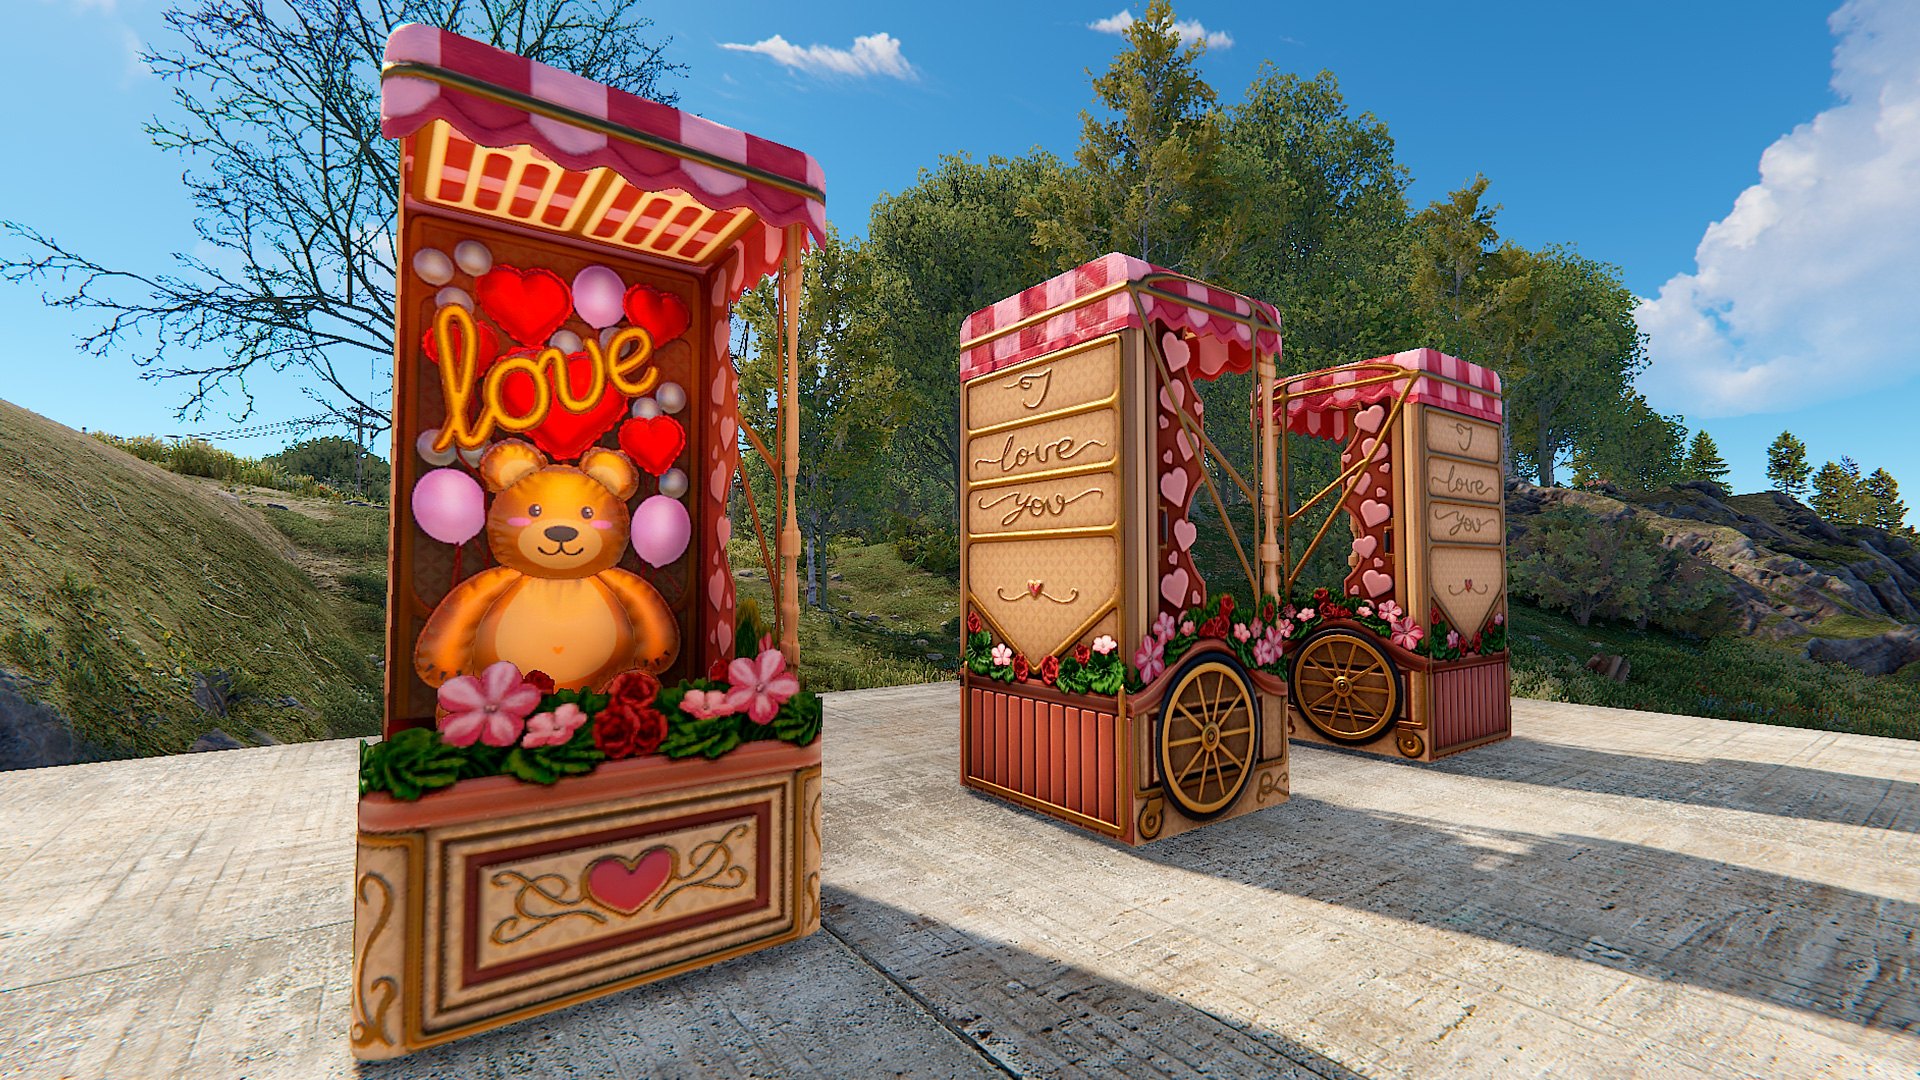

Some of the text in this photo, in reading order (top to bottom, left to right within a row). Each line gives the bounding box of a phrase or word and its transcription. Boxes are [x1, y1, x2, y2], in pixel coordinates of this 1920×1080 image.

[433, 303, 660, 452] love
[1003, 368, 1052, 409] I
[975, 434, 1107, 472] love
[1431, 465, 1496, 495] love
[978, 488, 1104, 526] you
[1434, 509, 1497, 536] you
